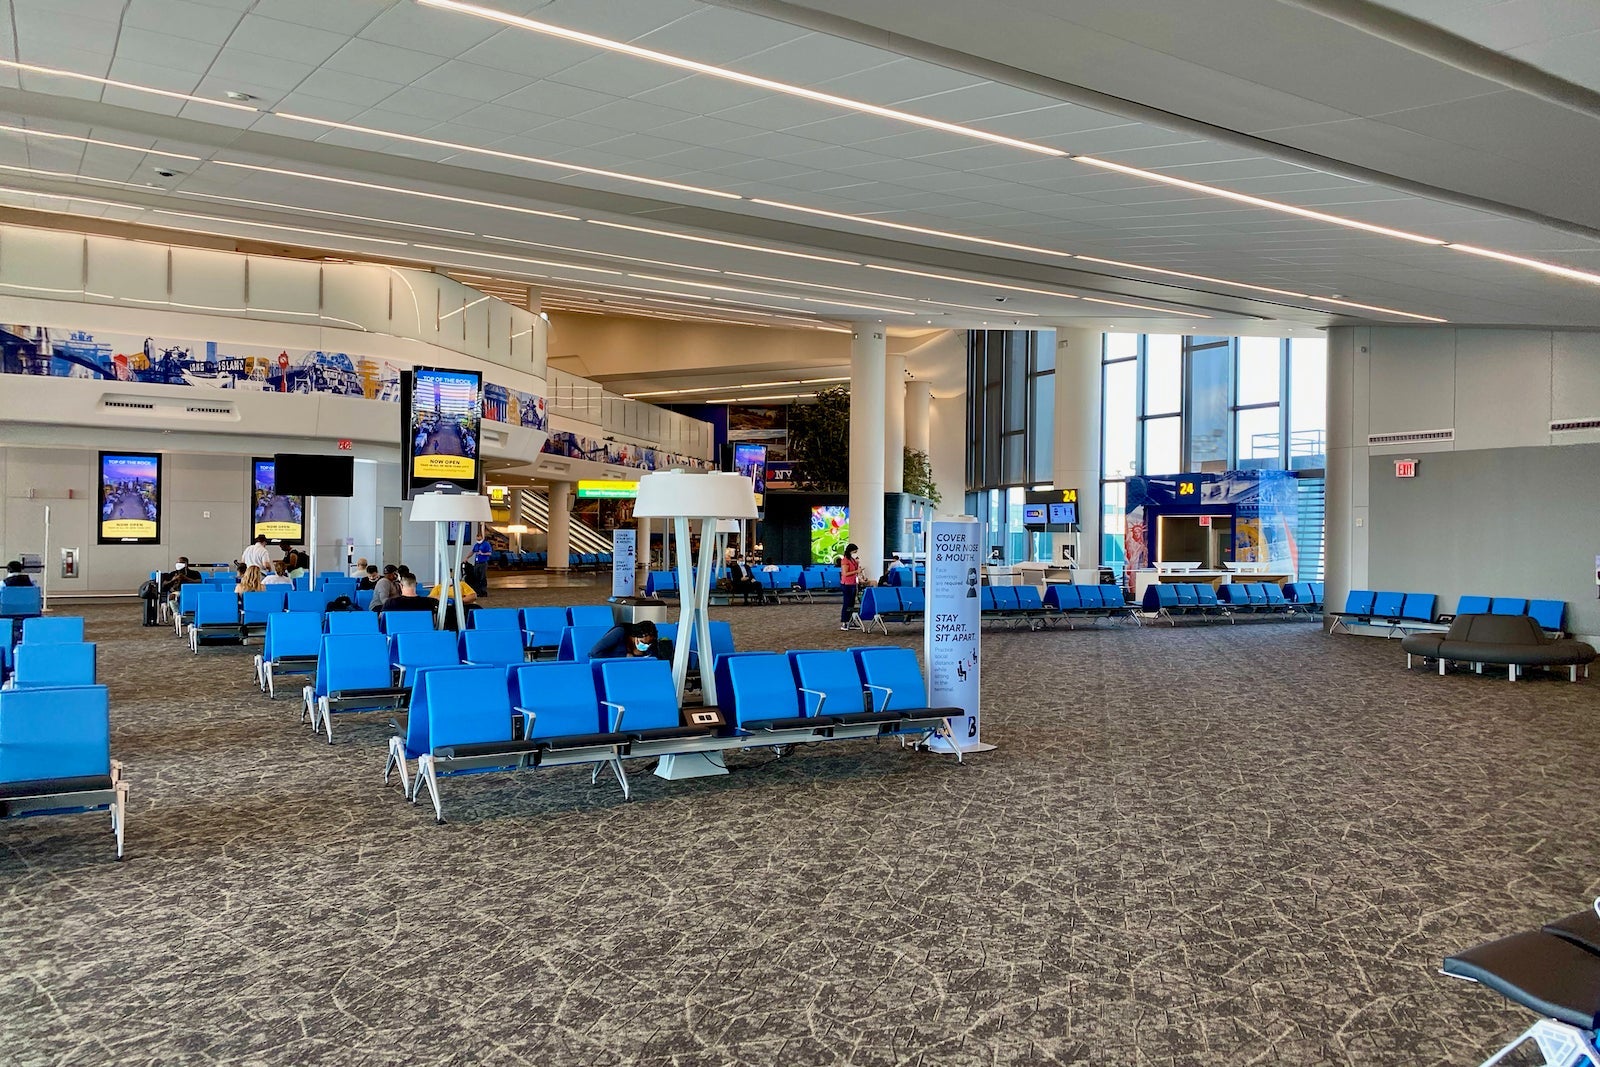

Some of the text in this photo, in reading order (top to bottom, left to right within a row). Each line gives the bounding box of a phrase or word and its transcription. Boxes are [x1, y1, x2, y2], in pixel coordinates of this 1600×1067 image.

[218, 359, 244, 371] ISLAND
[422, 375, 434, 383] TOP
[1398, 463, 1412, 475] EXIT
[774, 470, 792, 480] NY
[1179, 482, 1194, 495] 24
[1062, 489, 1076, 503] 24
[936, 533, 966, 542] COVER
[935, 543, 979, 552] YOUR NOSE
[935, 553, 943, 562] &
[935, 613, 959, 623] STAY
[935, 623, 967, 632] SMART.
[935, 633, 950, 642] SIT
